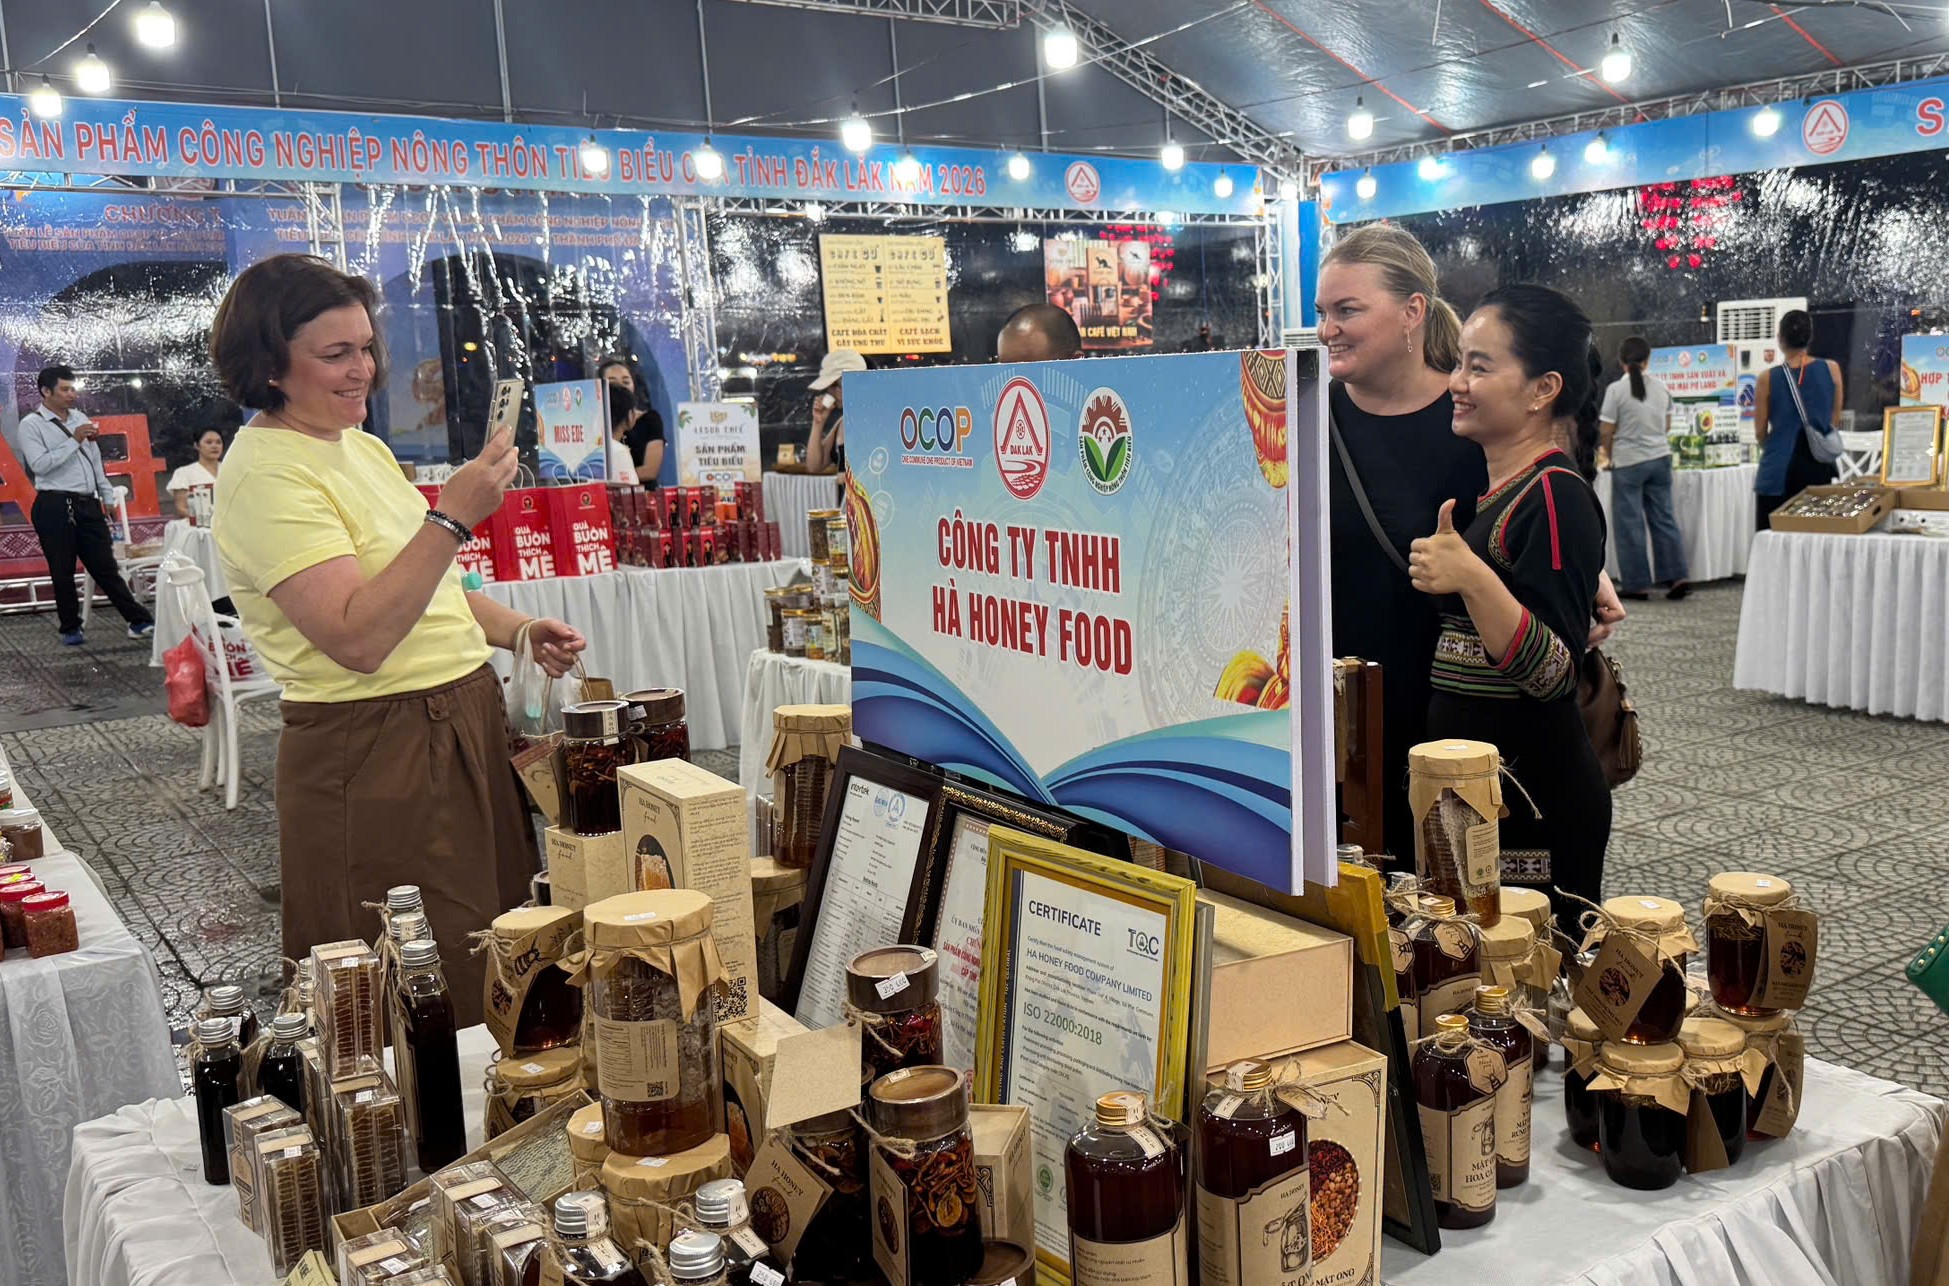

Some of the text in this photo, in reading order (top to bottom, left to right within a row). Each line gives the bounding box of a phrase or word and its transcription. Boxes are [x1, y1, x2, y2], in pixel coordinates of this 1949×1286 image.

[0, 108, 63, 159] SẢN
[75, 109, 168, 163] PHẨM
[180, 120, 264, 166] CÔNG
[276, 127, 381, 177] NGHIỆP
[391, 130, 469, 175] NÔNG
[477, 137, 548, 180] THÔN
[620, 136, 674, 183] BIỂU
[735, 146, 789, 187] TỈNH
[795, 147, 838, 189] ĐẮK
[939, 165, 987, 196] 2026
[1921, 371, 1943, 387] HỢP
[554, 425, 571, 444] MISS
[901, 407, 972, 453] OCOP
[717, 441, 746, 454] PHẨM
[515, 531, 551, 549] BUÔN
[573, 526, 609, 545] BUÔN
[575, 543, 600, 553] THÍCH
[518, 547, 543, 558] THÍCH
[577, 545, 614, 576] MÊ
[938, 509, 1121, 594] CÔNG TY TNHH
[519, 551, 556, 581] MÊ
[933, 578, 1133, 675] HÀ HONEY FOOD
[1029, 900, 1101, 937] CERTIFICATE
[1128, 928, 1159, 955] TQC
[1026, 948, 1152, 1002] HA HONEY FOOD COMPANY LIMITED
[1023, 1002, 1102, 1045] ISO 22000:2018
[771, 1159, 804, 1197] HA HONEY
[1280, 1183, 1305, 1200] HA HONEY
[1465, 1173, 1485, 1184] HOA
[1336, 1267, 1355, 1281] ONG
